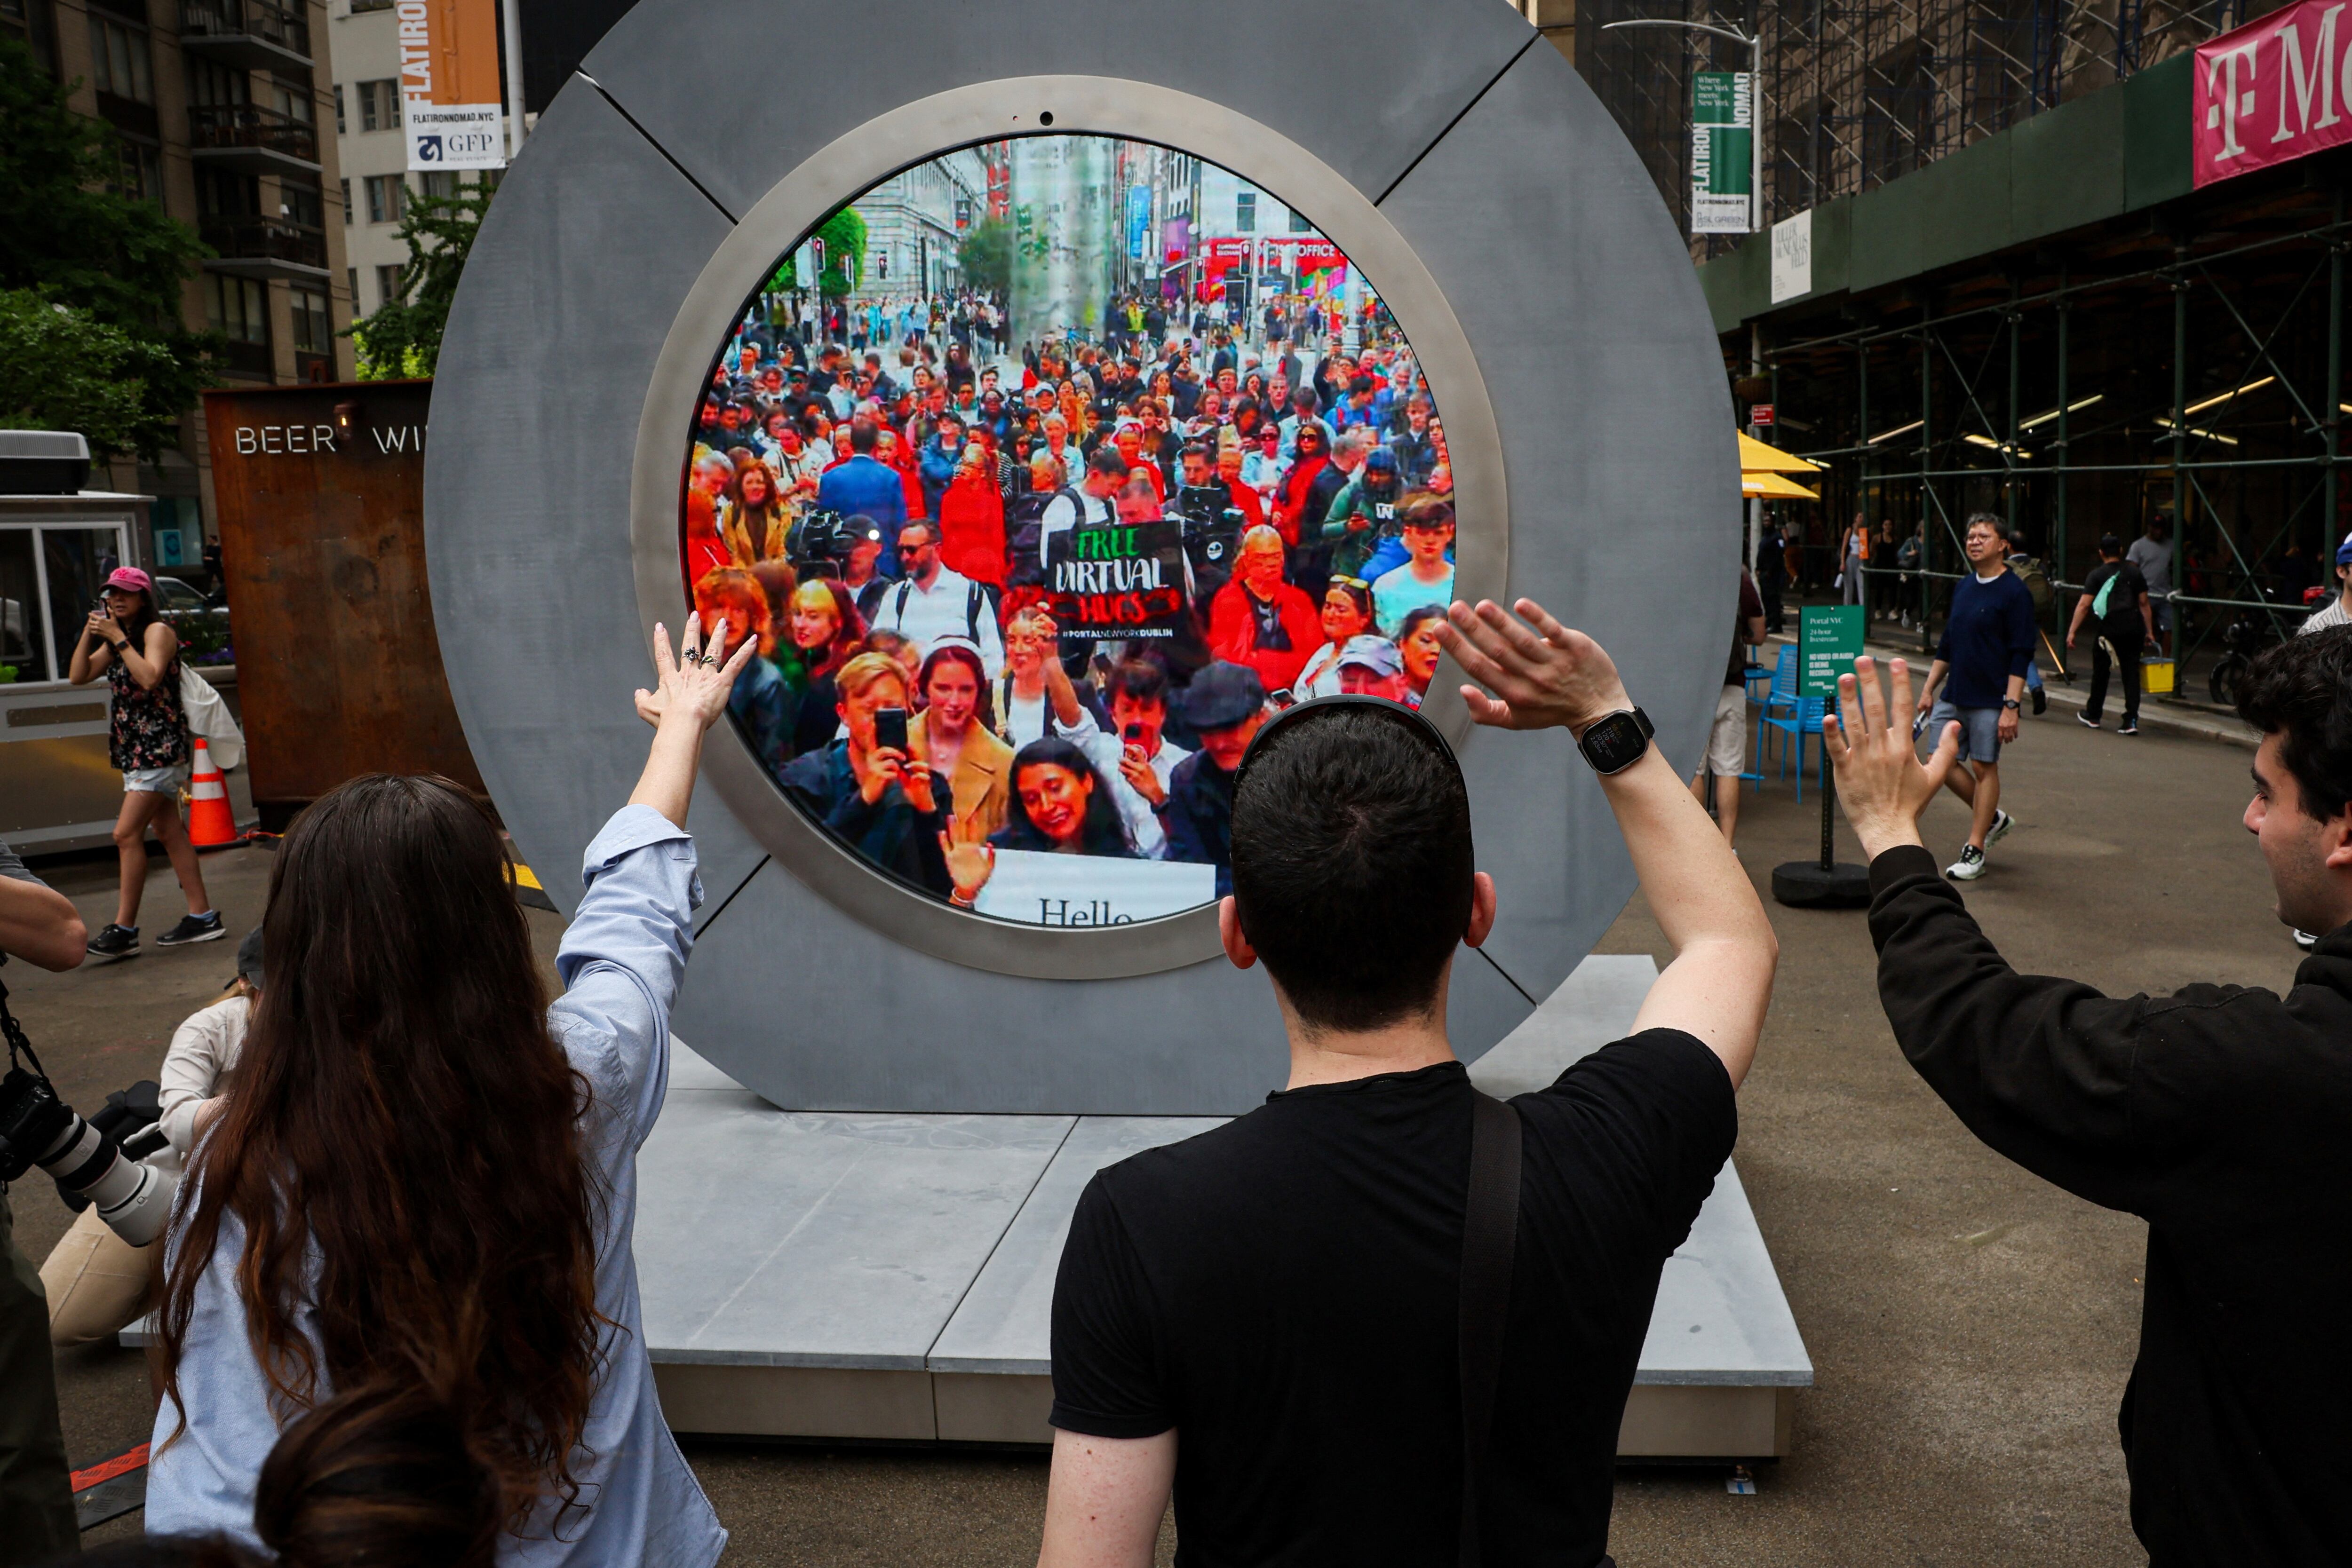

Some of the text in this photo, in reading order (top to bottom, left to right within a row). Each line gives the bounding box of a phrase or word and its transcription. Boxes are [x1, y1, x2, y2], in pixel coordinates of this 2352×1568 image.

[397, 0, 432, 107] FLATIRO
[1733, 72, 1751, 128] NOMAD
[413, 112, 494, 123] FLATIRONNOMAD.NYC
[449, 134, 493, 152] GFP
[1692, 123, 1710, 194] FLATIRON
[1298, 244, 1335, 257] OFFICE
[236, 425, 429, 454] BEER WI
[1077, 528, 1142, 560] FREE
[1056, 557, 1170, 594] VIRTUAL
[1079, 591, 1145, 624] HUGS
[1606, 727, 1615, 737] 219
